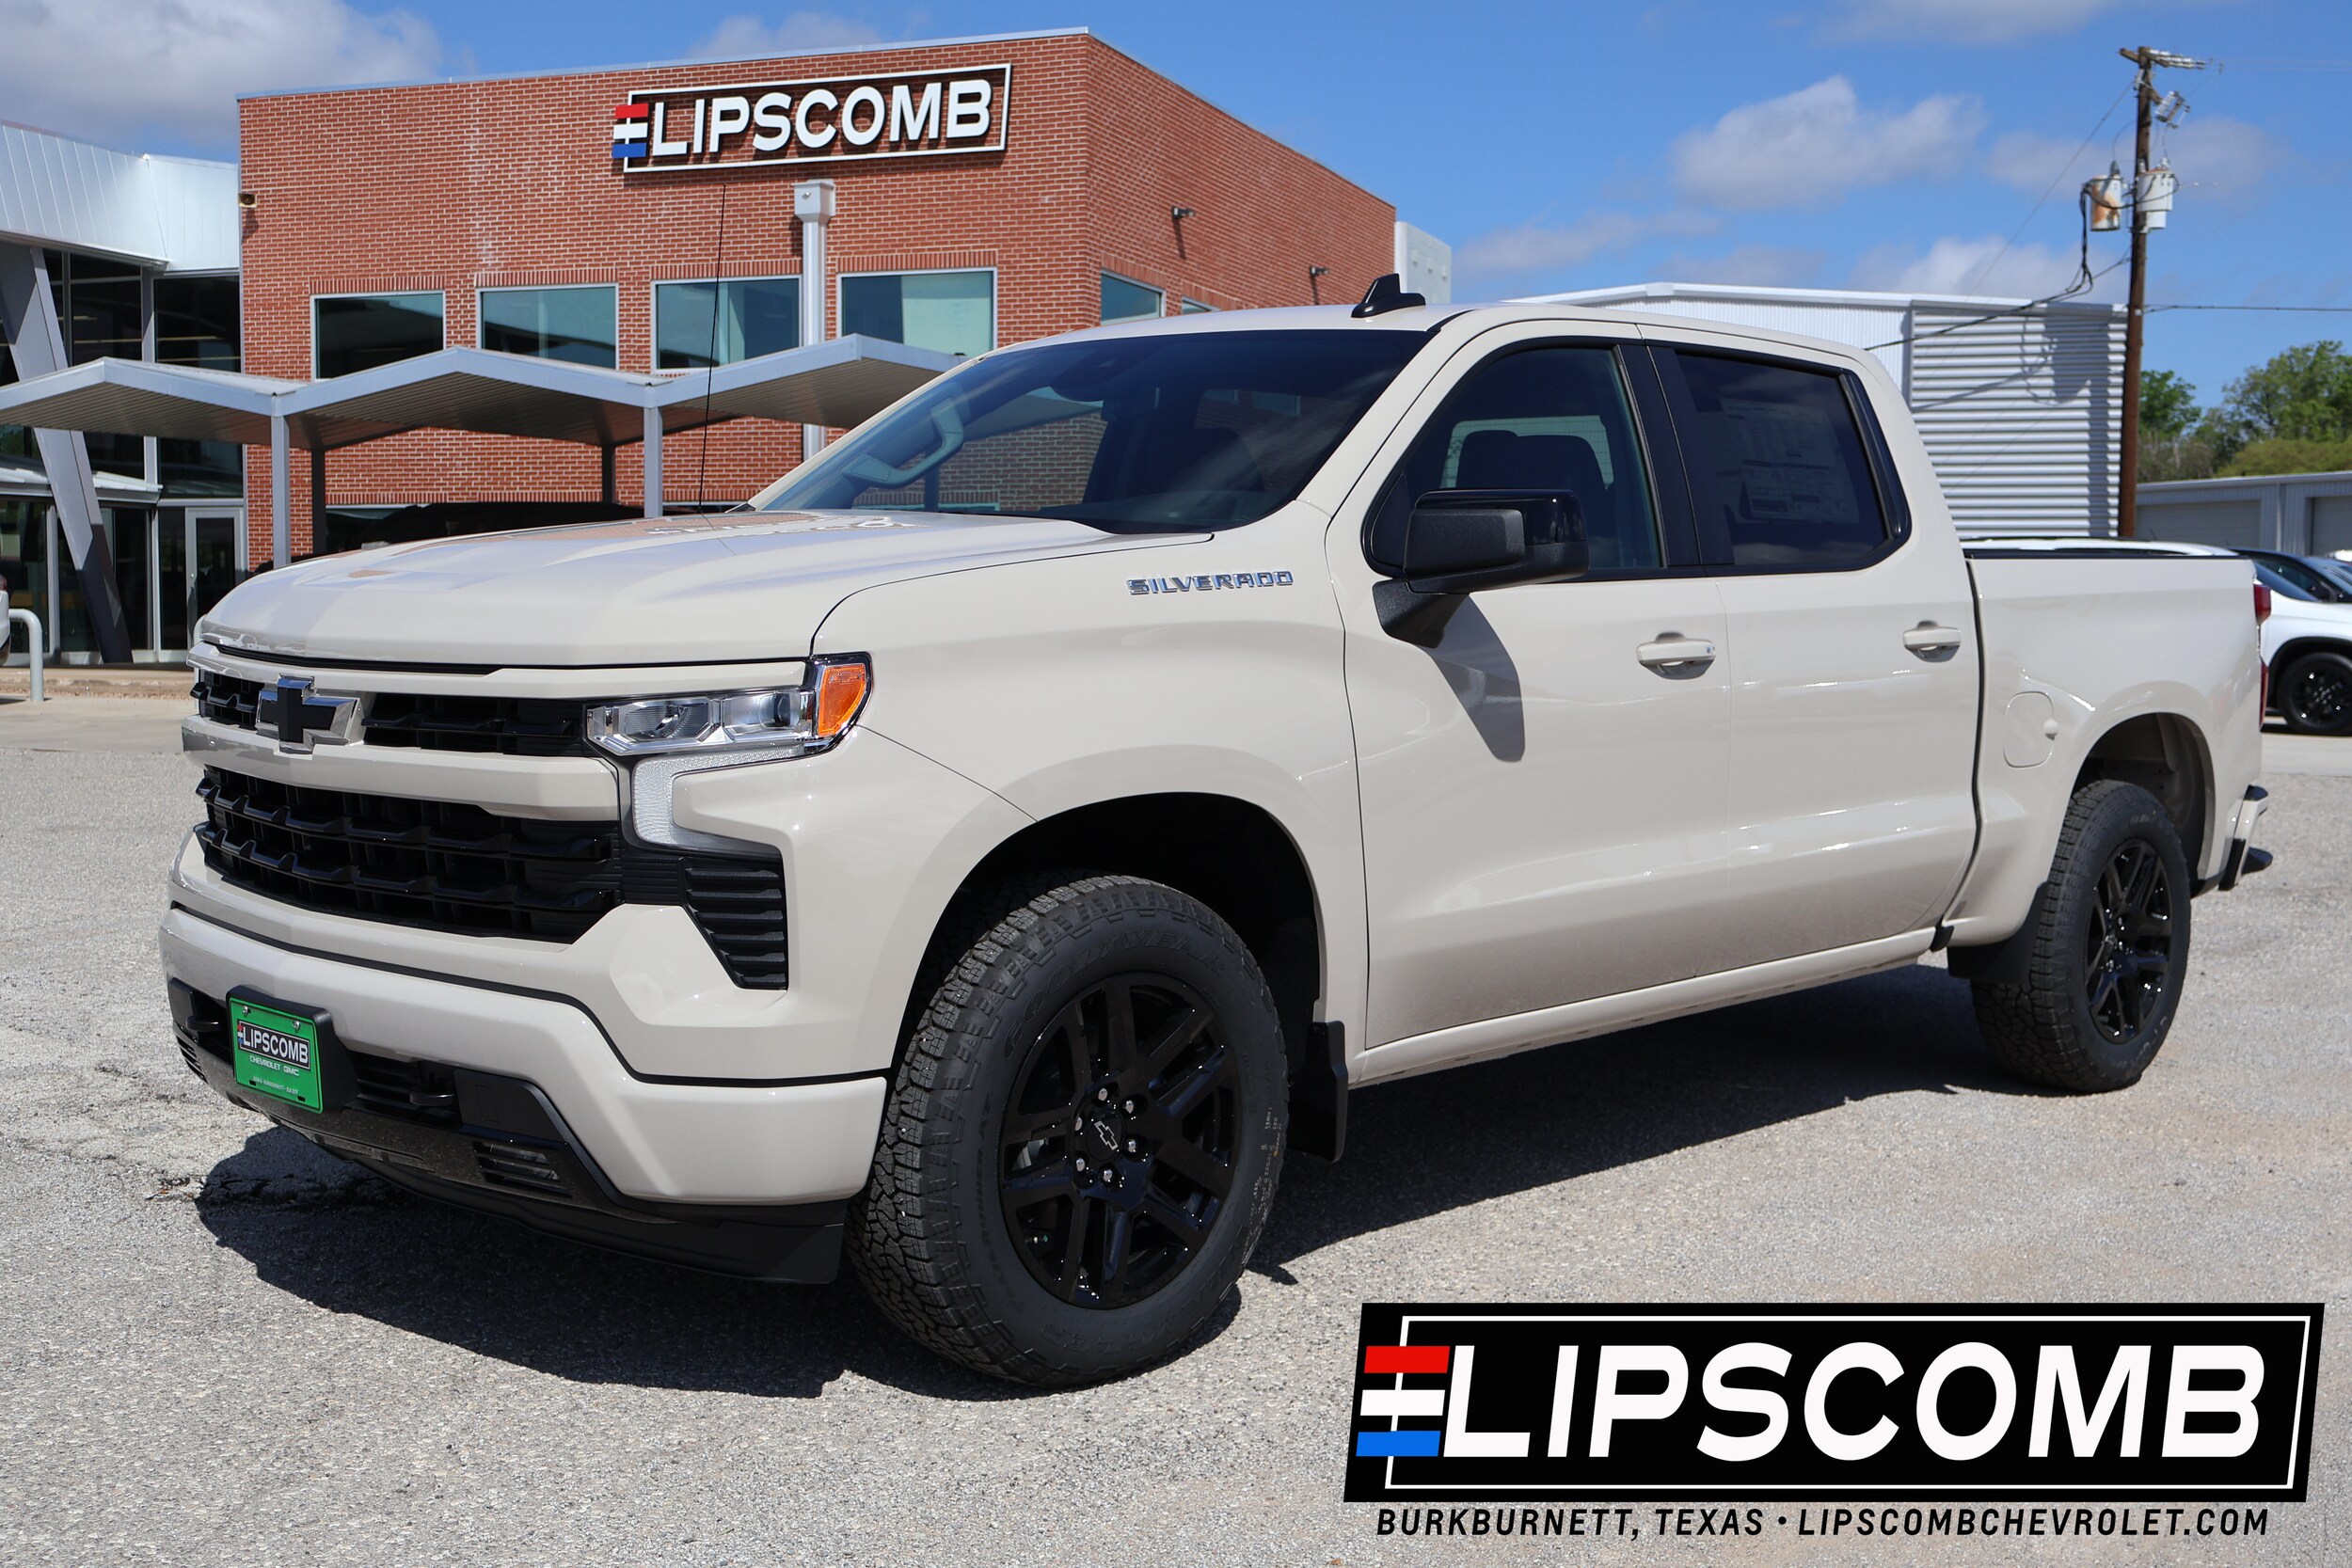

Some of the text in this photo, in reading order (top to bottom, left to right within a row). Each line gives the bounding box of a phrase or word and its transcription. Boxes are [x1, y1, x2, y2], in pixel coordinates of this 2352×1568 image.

[653, 79, 993, 156] LIPSCOMB
[1126, 571, 1294, 595] SILVERADO
[243, 1026, 309, 1064] LIPSCOMB
[249, 1054, 300, 1077] CHEVROLET GMC
